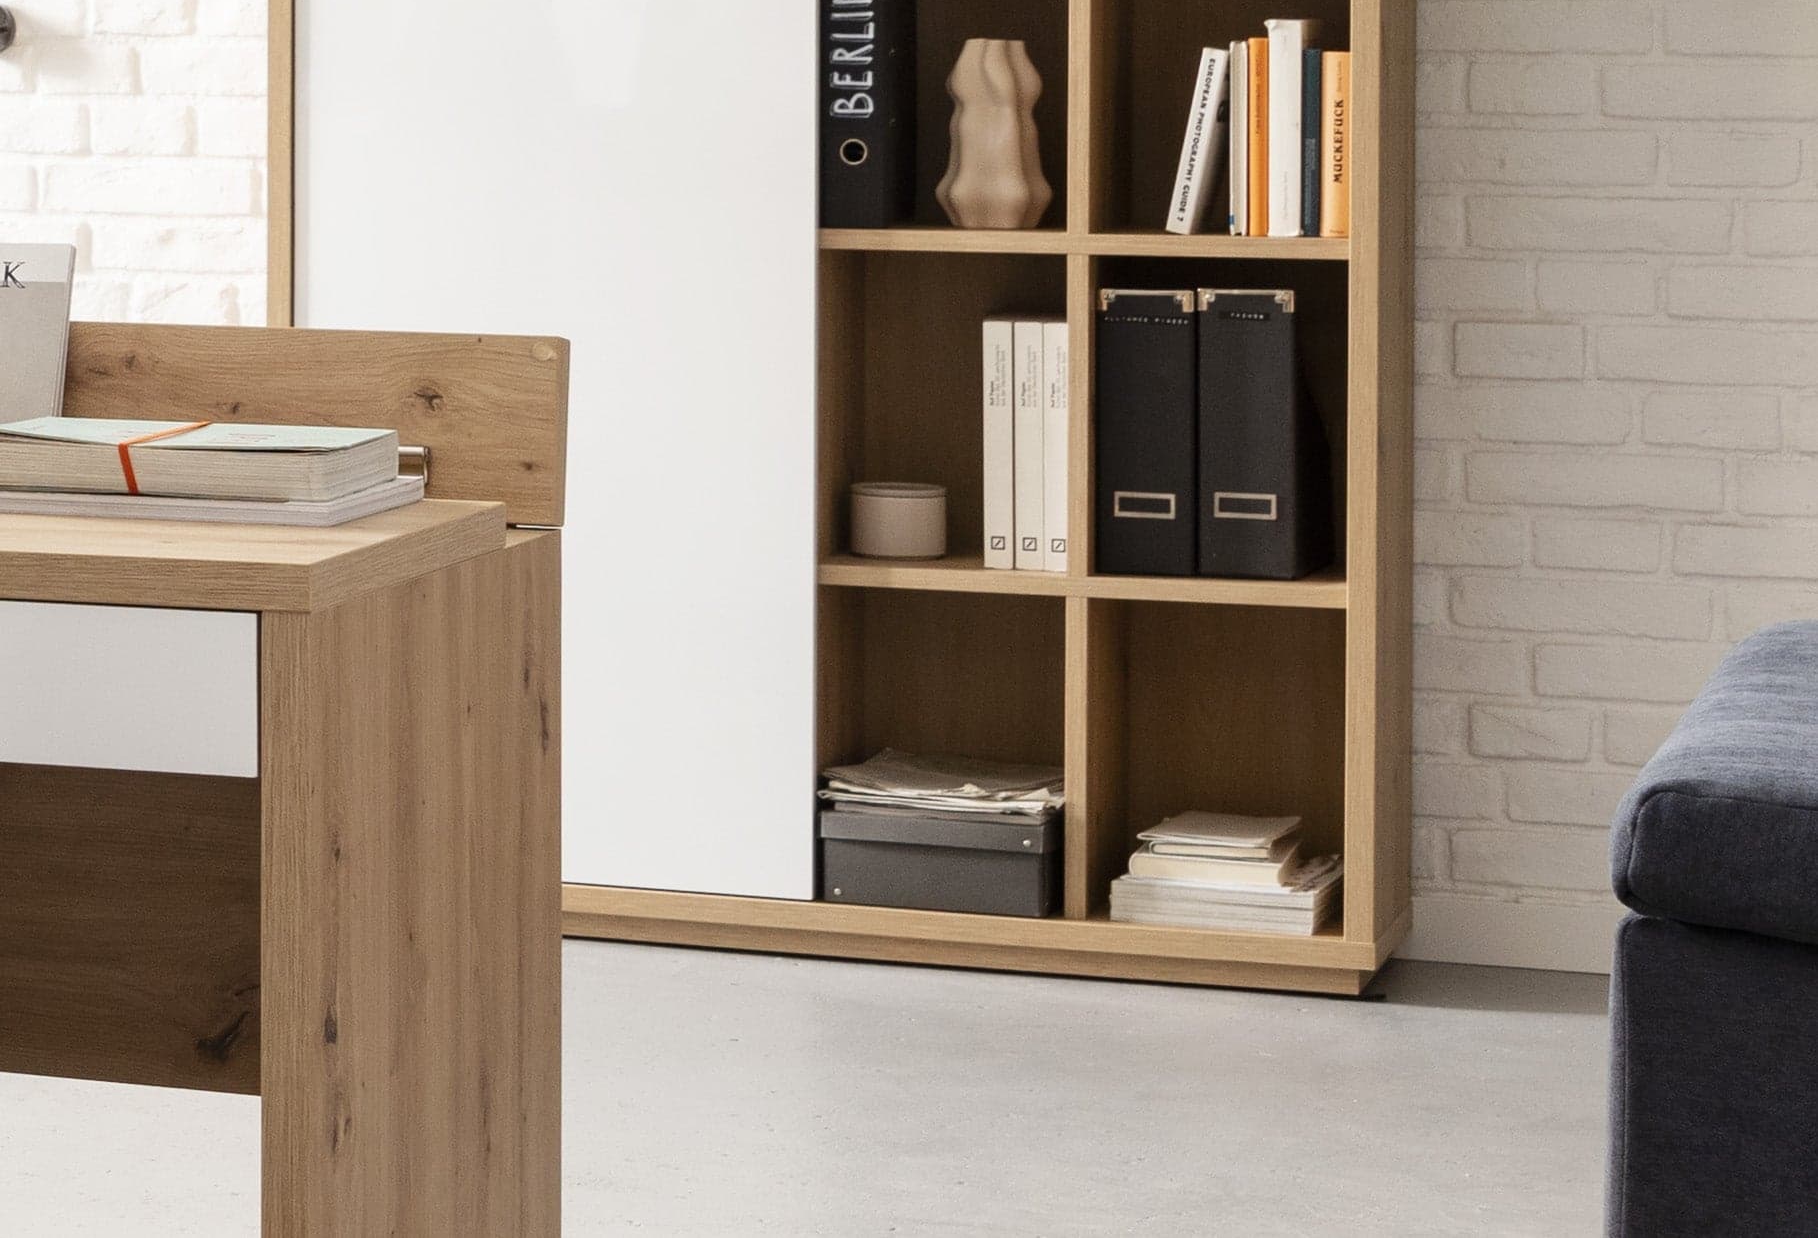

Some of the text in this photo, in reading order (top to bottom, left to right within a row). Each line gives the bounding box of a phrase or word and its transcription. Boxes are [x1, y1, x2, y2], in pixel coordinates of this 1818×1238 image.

[1200, 58, 1216, 109] EUROPEAN
[1185, 112, 1205, 181] PHOTOGRAPHY
[1333, 99, 1344, 183] MUCKEFUCK
[1179, 185, 1190, 214] GUIDE
